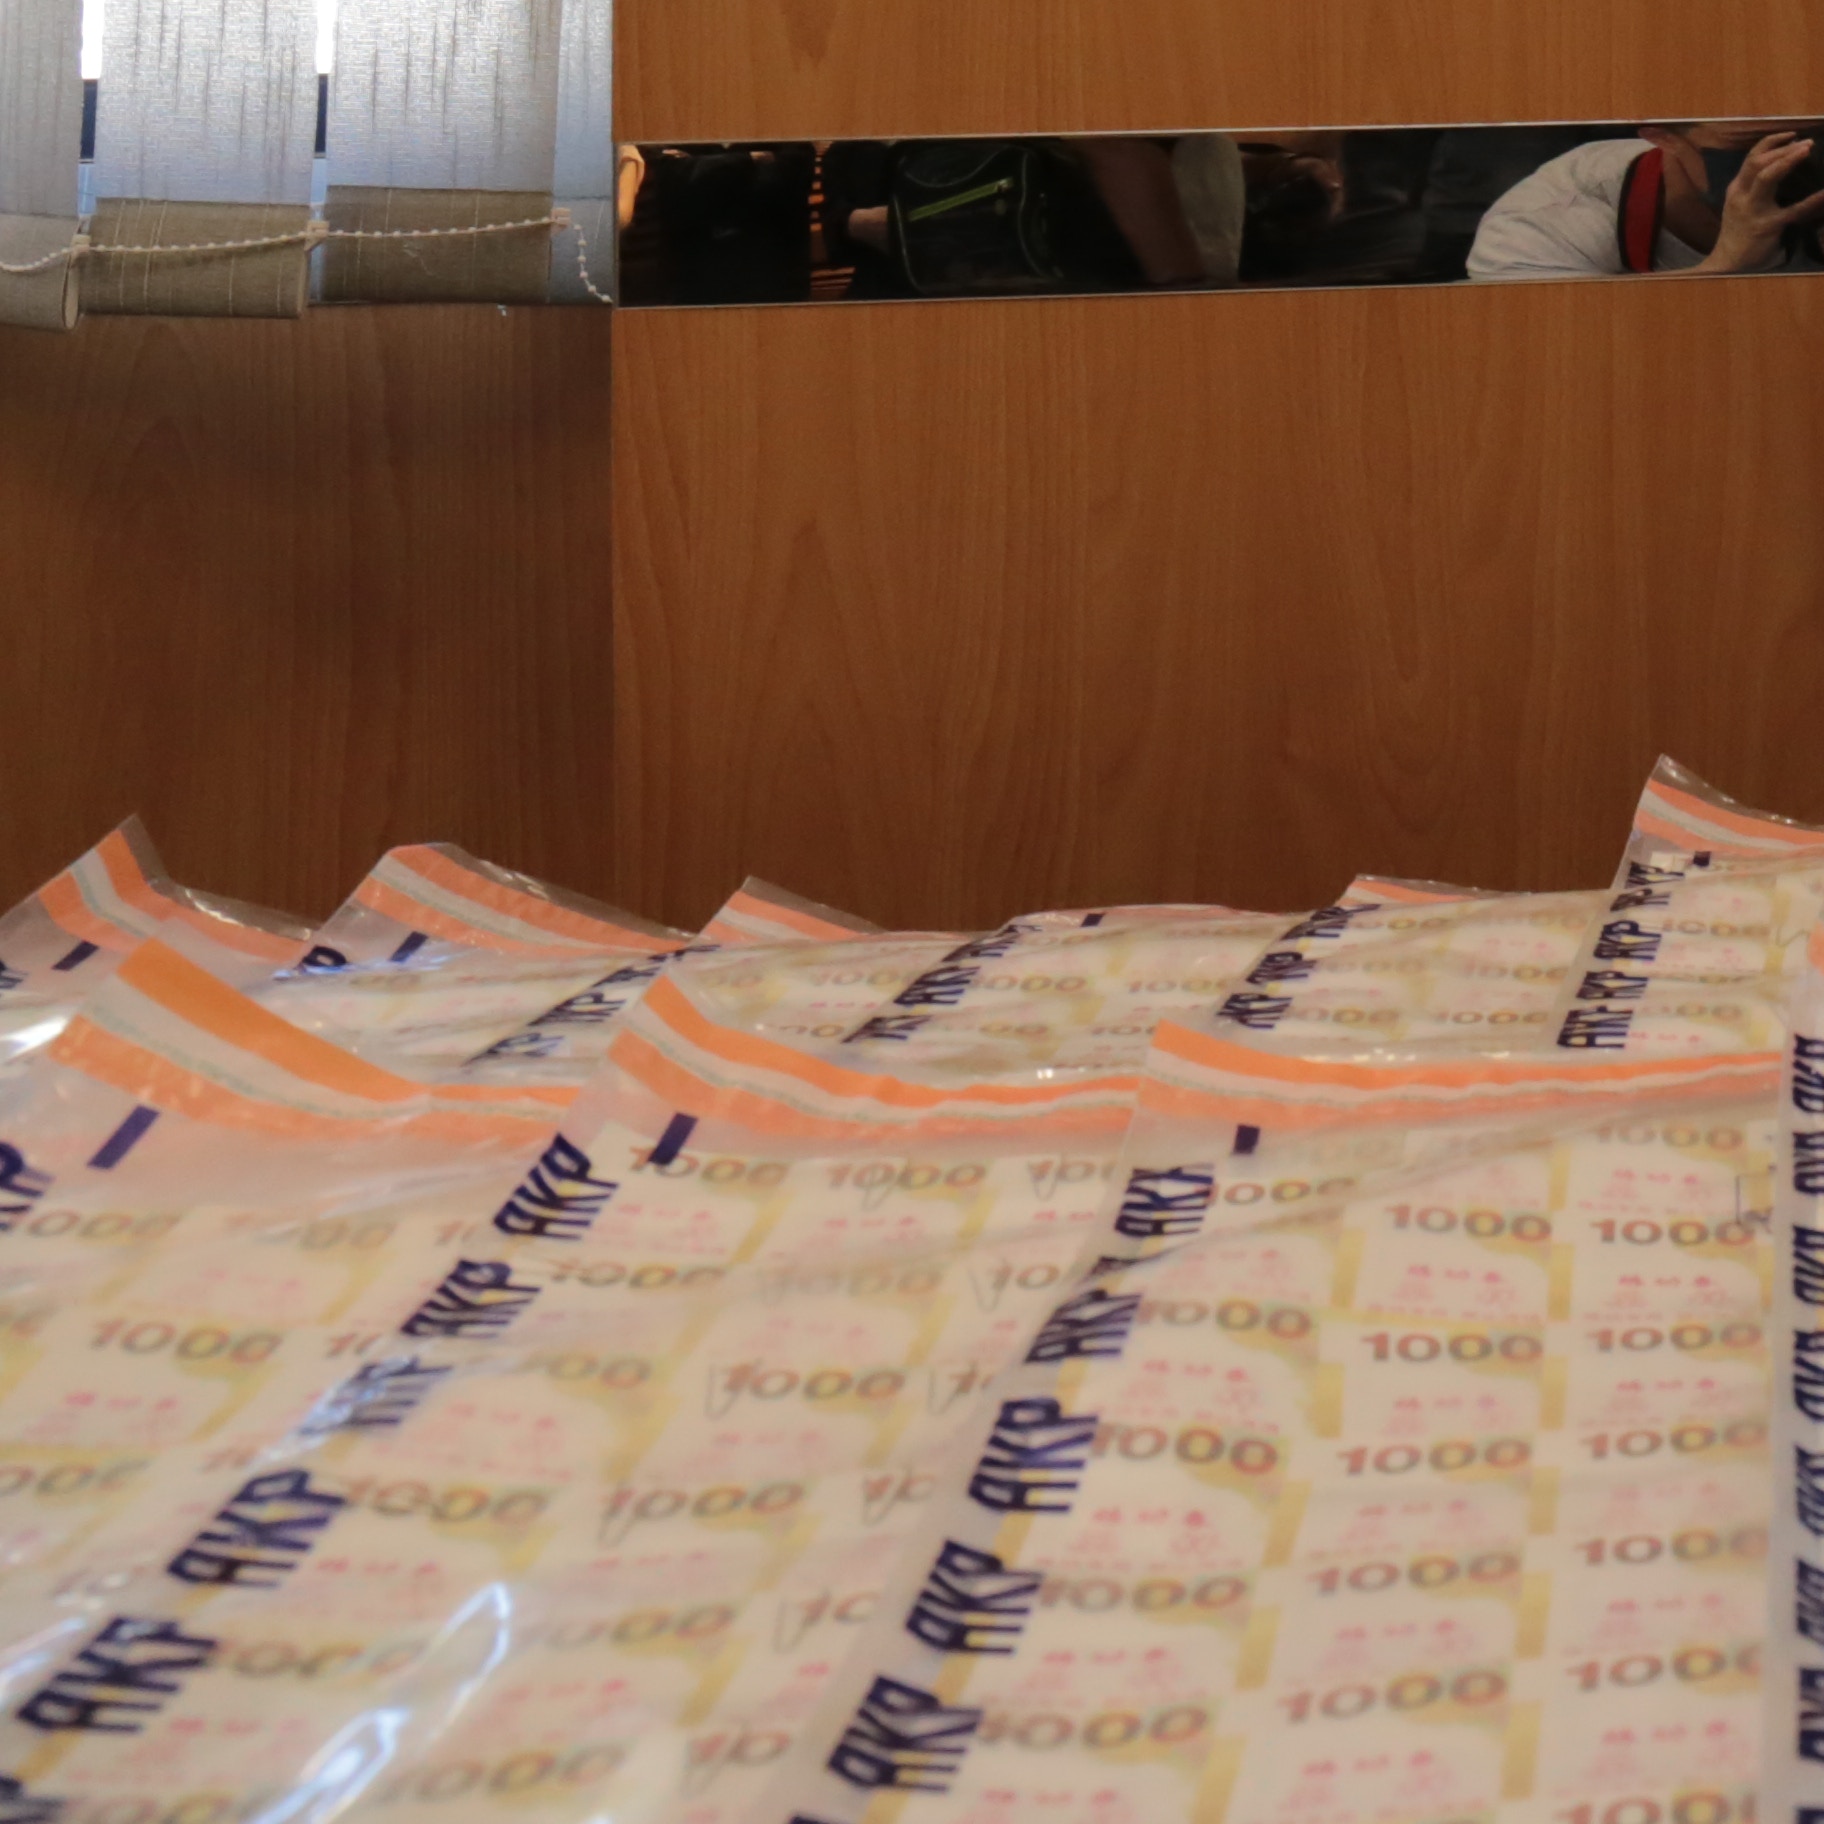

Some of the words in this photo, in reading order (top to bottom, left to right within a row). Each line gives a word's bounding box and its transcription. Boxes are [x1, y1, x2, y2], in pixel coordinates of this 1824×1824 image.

[1384, 1204, 1552, 1244] 1000
[1591, 1218, 1756, 1247] 1000
[1138, 1297, 1312, 1339] 1000
[1587, 1321, 1764, 1353] 1000
[1360, 1330, 1544, 1364] 1000
[722, 1360, 907, 1402] 1000
[1337, 1435, 1533, 1476] 1000
[1580, 1420, 1769, 1461] 1000
[604, 1481, 807, 1524] 1000
[1575, 1528, 1770, 1568] 1000
[1309, 1552, 1521, 1597] 1000
[1278, 1669, 1509, 1724] 1000
